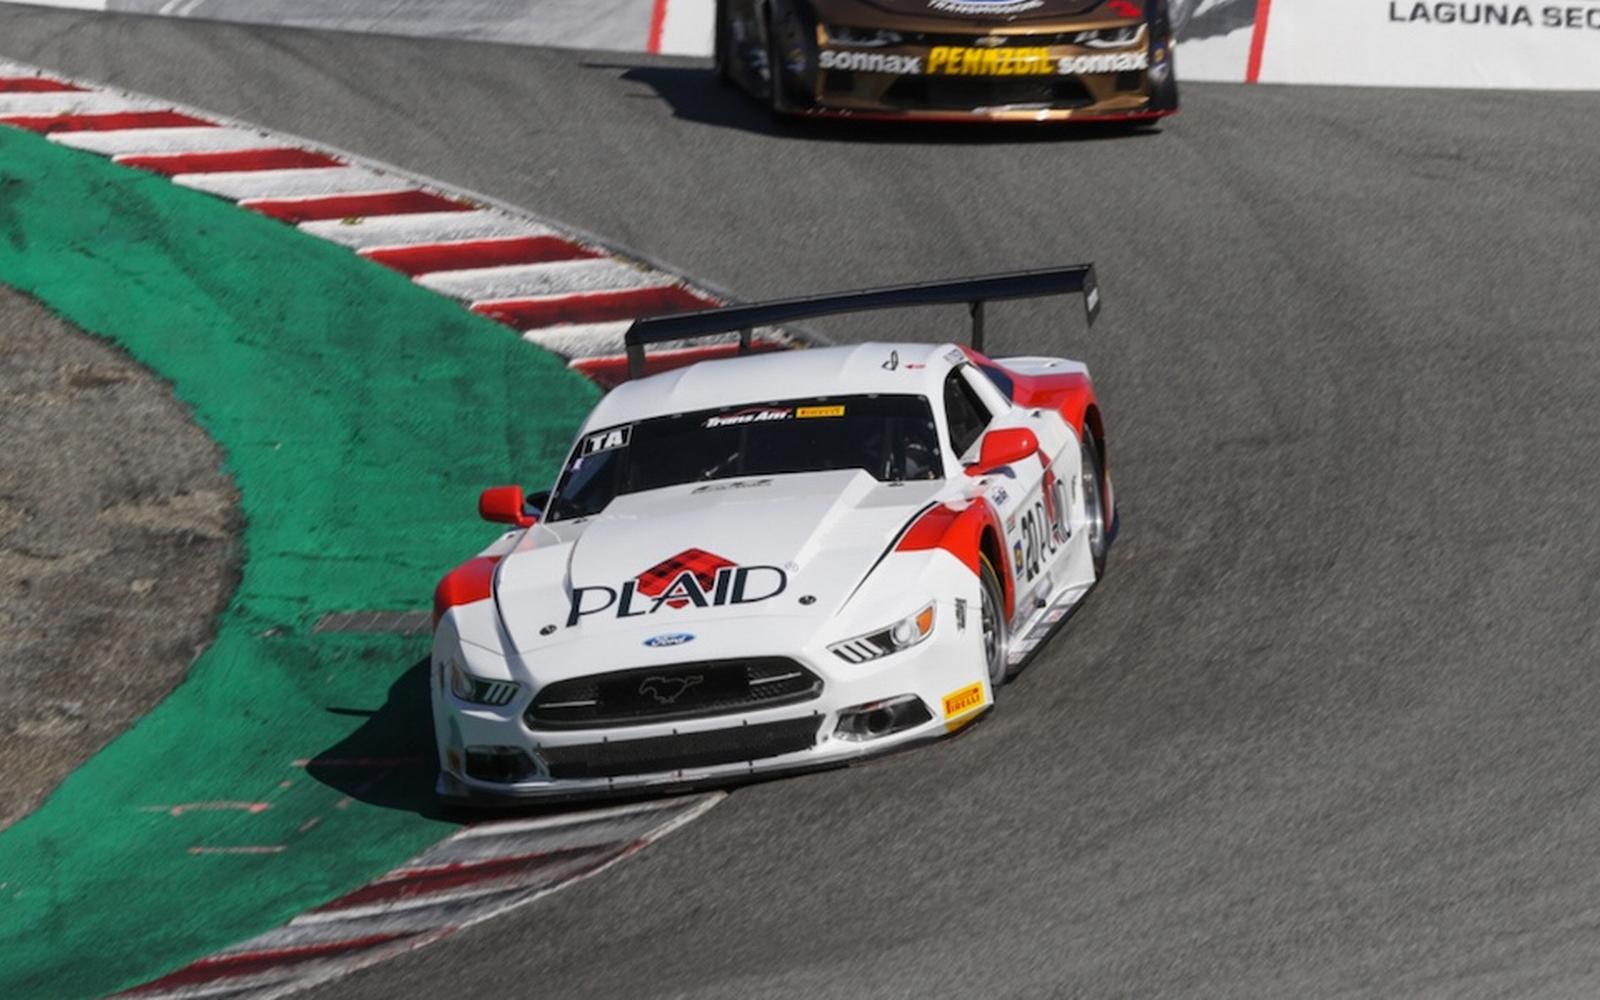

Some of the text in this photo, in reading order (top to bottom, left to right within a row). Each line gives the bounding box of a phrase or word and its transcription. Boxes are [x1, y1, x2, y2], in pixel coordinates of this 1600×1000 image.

[1389, 1, 1534, 27] LAGUNA
[818, 48, 922, 75] sonnax
[926, 46, 1055, 76] PENNZOIL
[1056, 50, 1149, 75] sonnax
[590, 429, 623, 452] TA
[565, 564, 788, 628] PLAID
